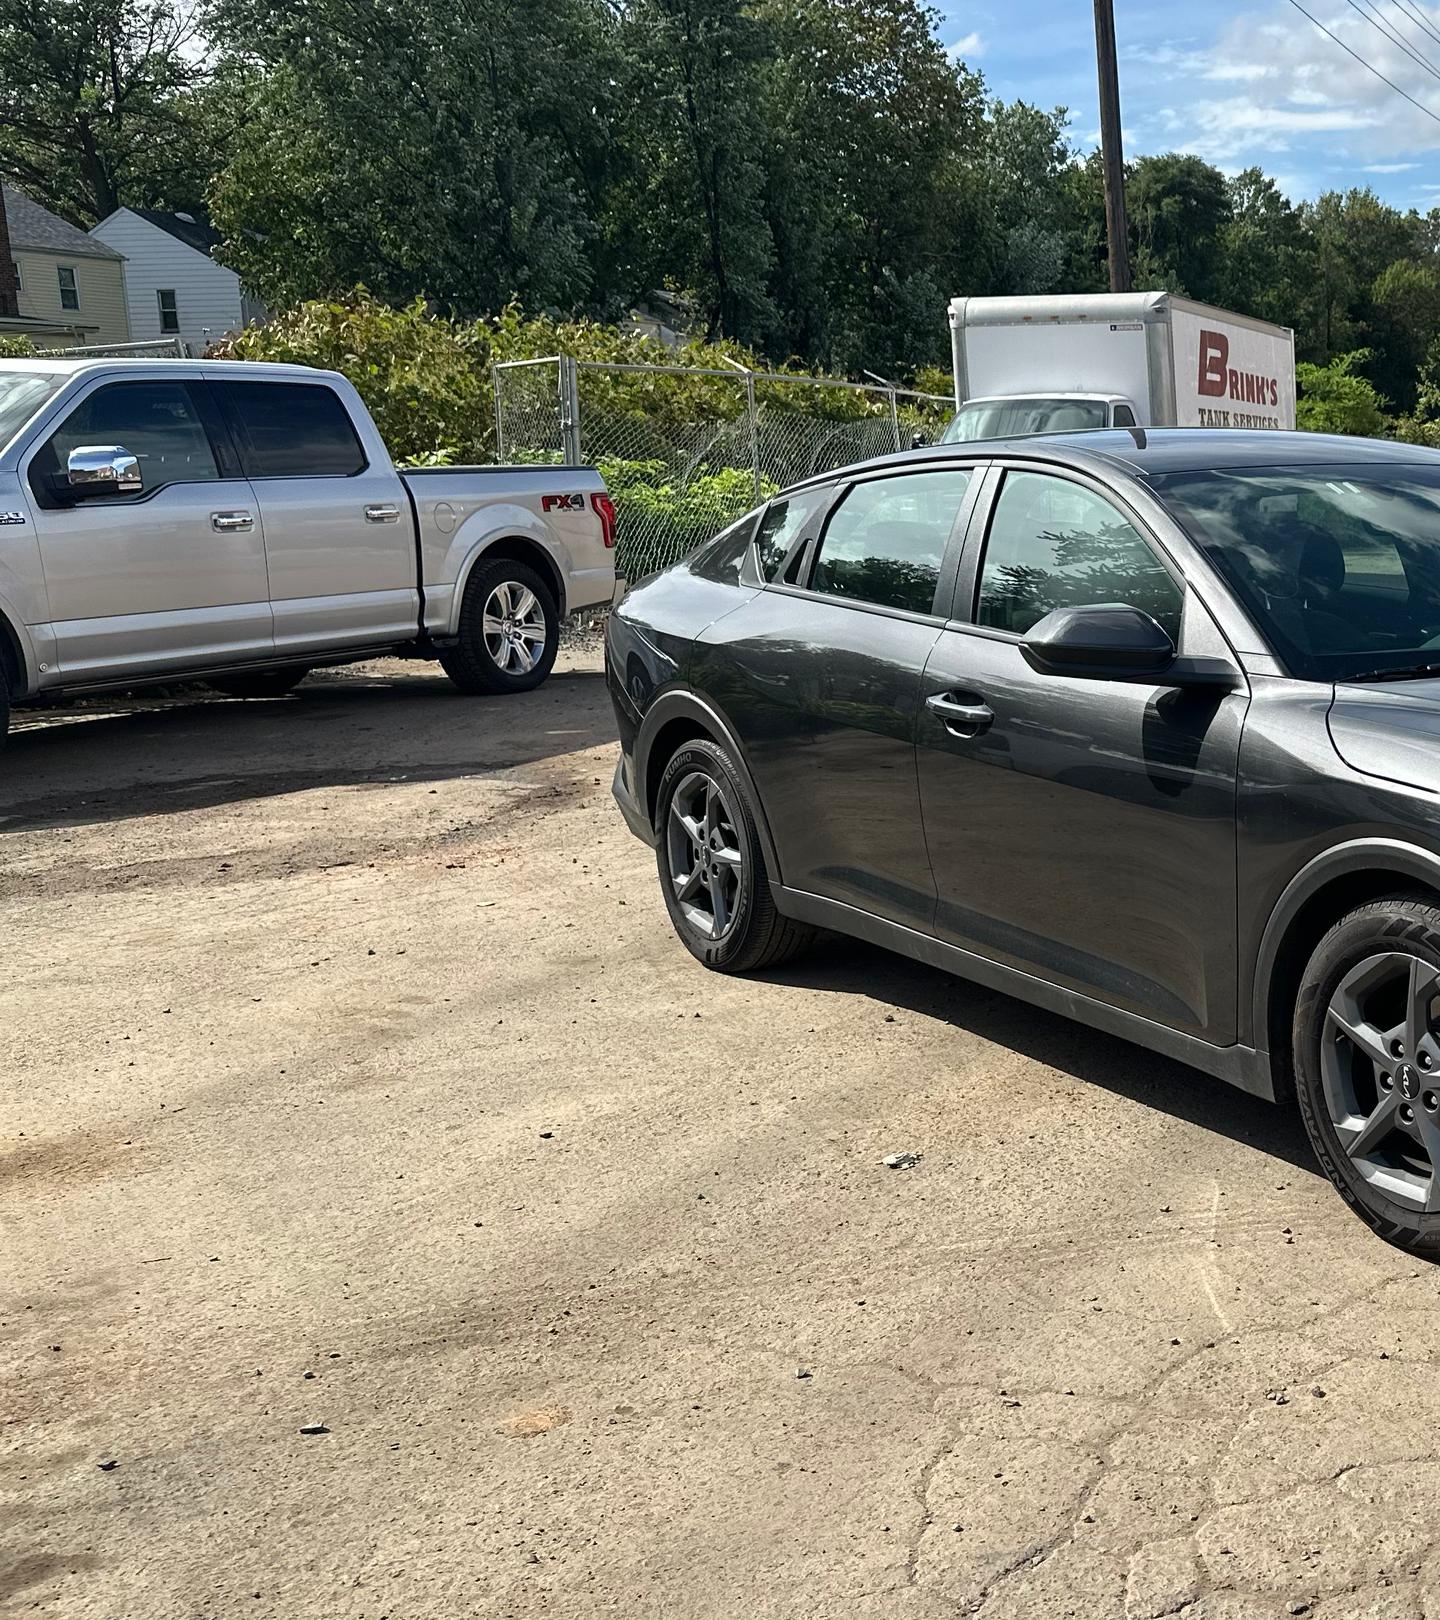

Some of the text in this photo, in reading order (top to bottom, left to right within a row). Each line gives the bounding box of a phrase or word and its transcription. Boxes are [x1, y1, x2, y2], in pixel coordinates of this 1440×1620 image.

[1198, 329, 1279, 406] BRINK'S
[1199, 408, 1279, 429] TANK SERVICES
[542, 494, 585, 512] FX4
[665, 752, 692, 783] KUMHO
